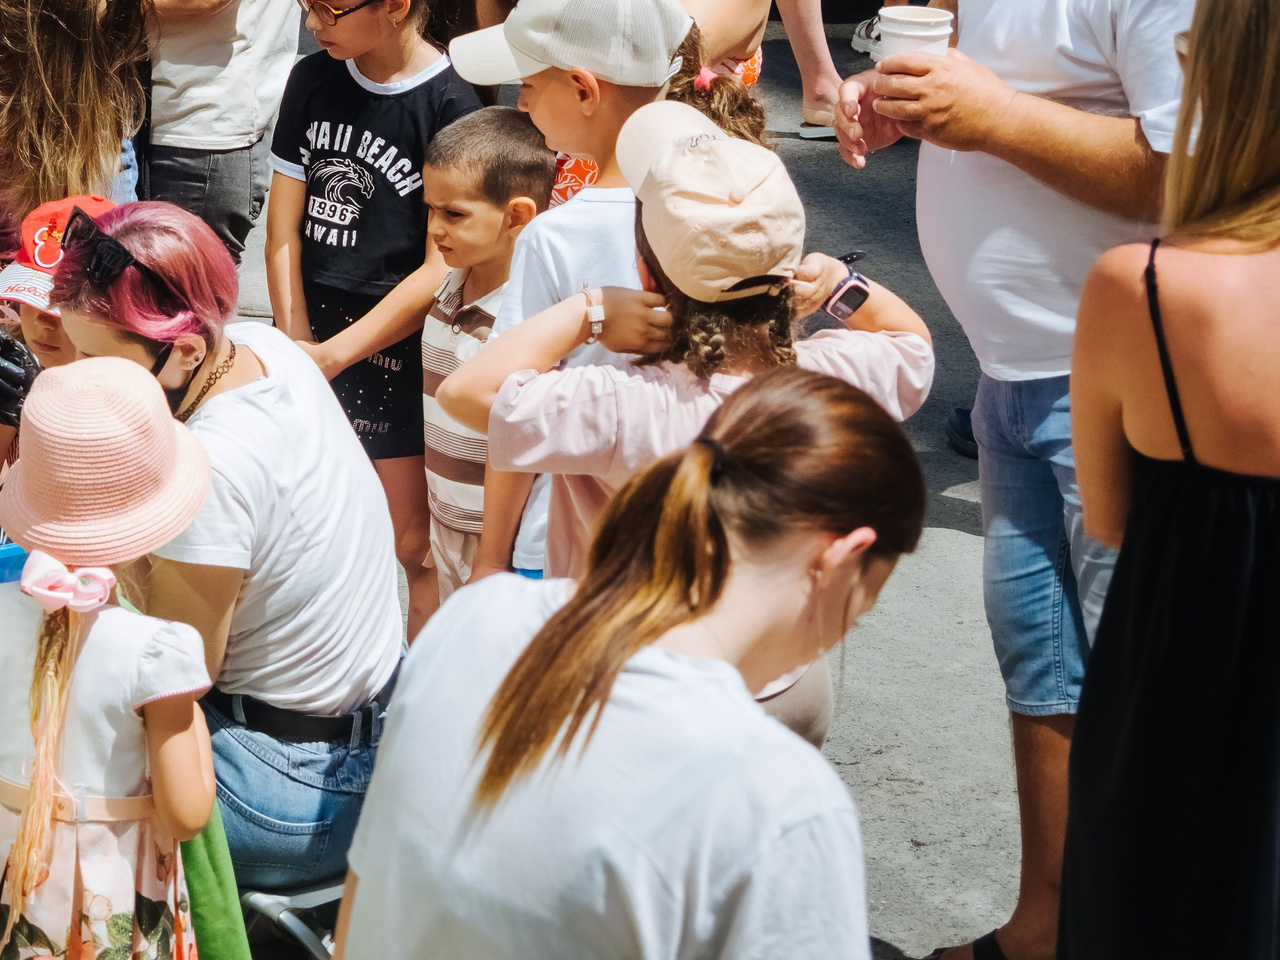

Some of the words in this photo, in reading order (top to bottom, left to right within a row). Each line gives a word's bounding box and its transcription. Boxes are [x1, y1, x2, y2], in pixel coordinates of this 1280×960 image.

[356, 130, 423, 198] BEACH
[310, 198, 349, 222] 1996
[305, 220, 357, 247] AWAII
